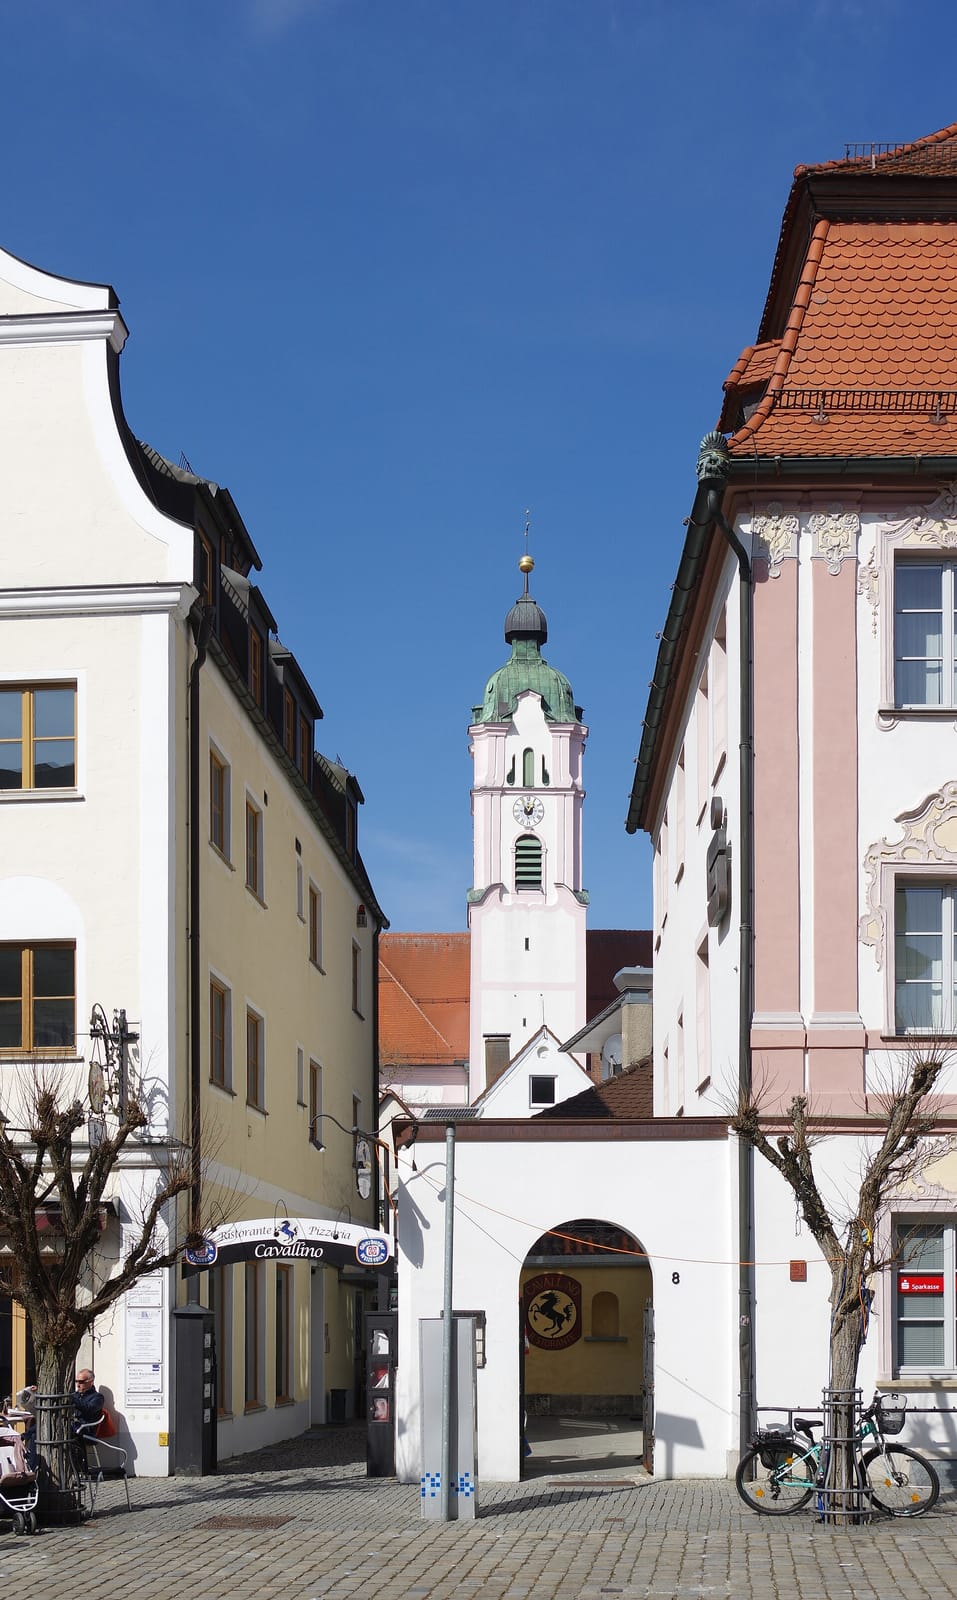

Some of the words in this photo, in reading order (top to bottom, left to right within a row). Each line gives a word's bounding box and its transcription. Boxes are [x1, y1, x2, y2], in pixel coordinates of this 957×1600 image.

[219, 1226, 272, 1239] Ristorante
[308, 1226, 352, 1240] Pizzeria
[254, 1241, 324, 1258] Cavallino
[672, 1272, 680, 1285] 8
[525, 1277, 579, 1296] CAVALLNO
[911, 1283, 940, 1291] Sparkasse
